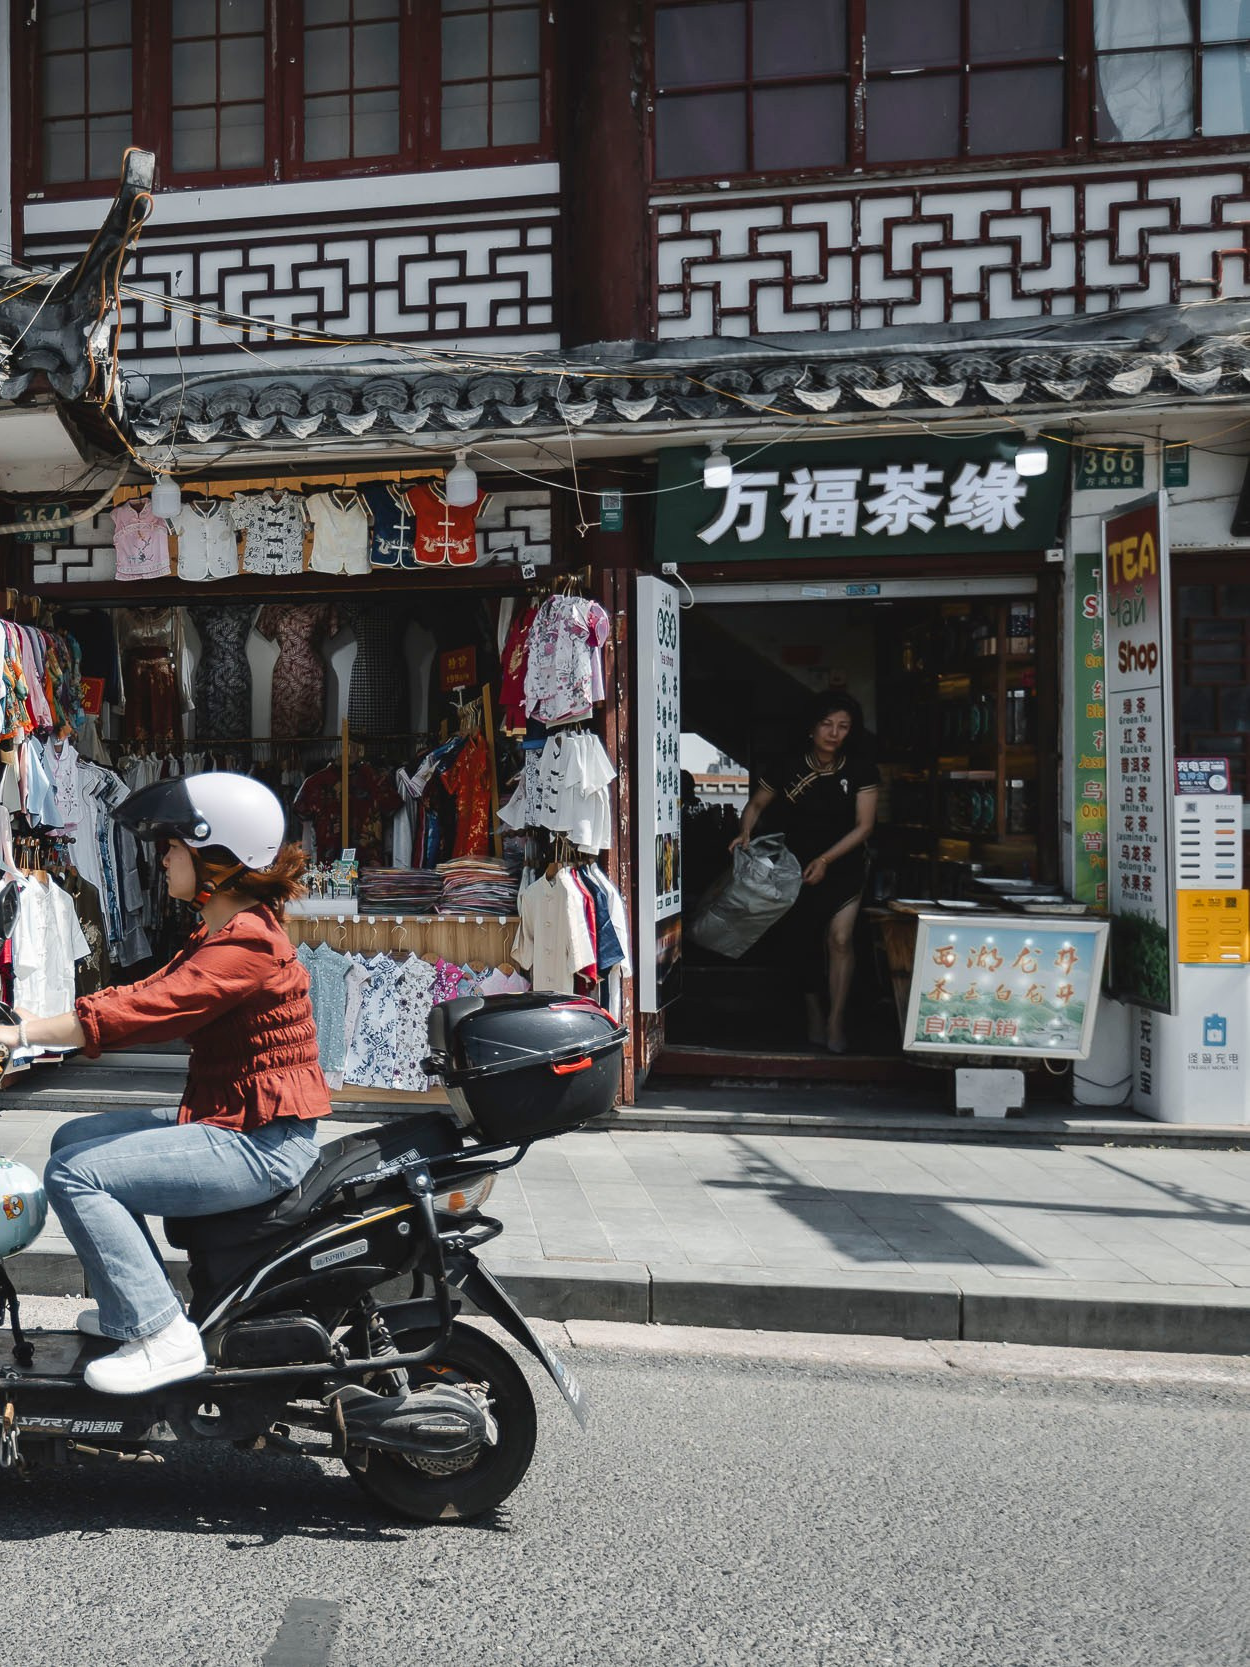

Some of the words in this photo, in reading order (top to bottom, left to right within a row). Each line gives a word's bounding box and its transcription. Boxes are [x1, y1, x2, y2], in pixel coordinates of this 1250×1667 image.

[1085, 450, 1134, 475] 366
[697, 462, 1028, 545] 万福茶缘
[1108, 532, 1157, 585] TEA
[1108, 584, 1146, 628] Чай
[1118, 640, 1158, 675] Shop
[1119, 716, 1138, 725] Green
[1140, 714, 1152, 723] Tea
[1123, 727, 1146, 743] 红茶
[1120, 745, 1138, 754] Black
[1140, 744, 1152, 753] Tea
[1121, 757, 1150, 773] 普洱茶
[1139, 774, 1151, 783] Tea
[1125, 786, 1148, 802] 白茶
[1120, 803, 1139, 812] White
[1141, 804, 1154, 813] Tea
[1124, 816, 1147, 832] 花茶
[1144, 834, 1158, 843] Tea
[1121, 844, 1151, 862] 乌龙茶
[1117, 861, 1142, 873] Oolong
[1144, 864, 1157, 873] Tea
[1121, 873, 1152, 892] 水果茶
[1140, 892, 1152, 902] Tea
[933, 946, 1079, 975] 西湖龙井
[925, 1015, 1018, 1037] 自产自销
[71, 1420, 124, 1433] 舒适版
